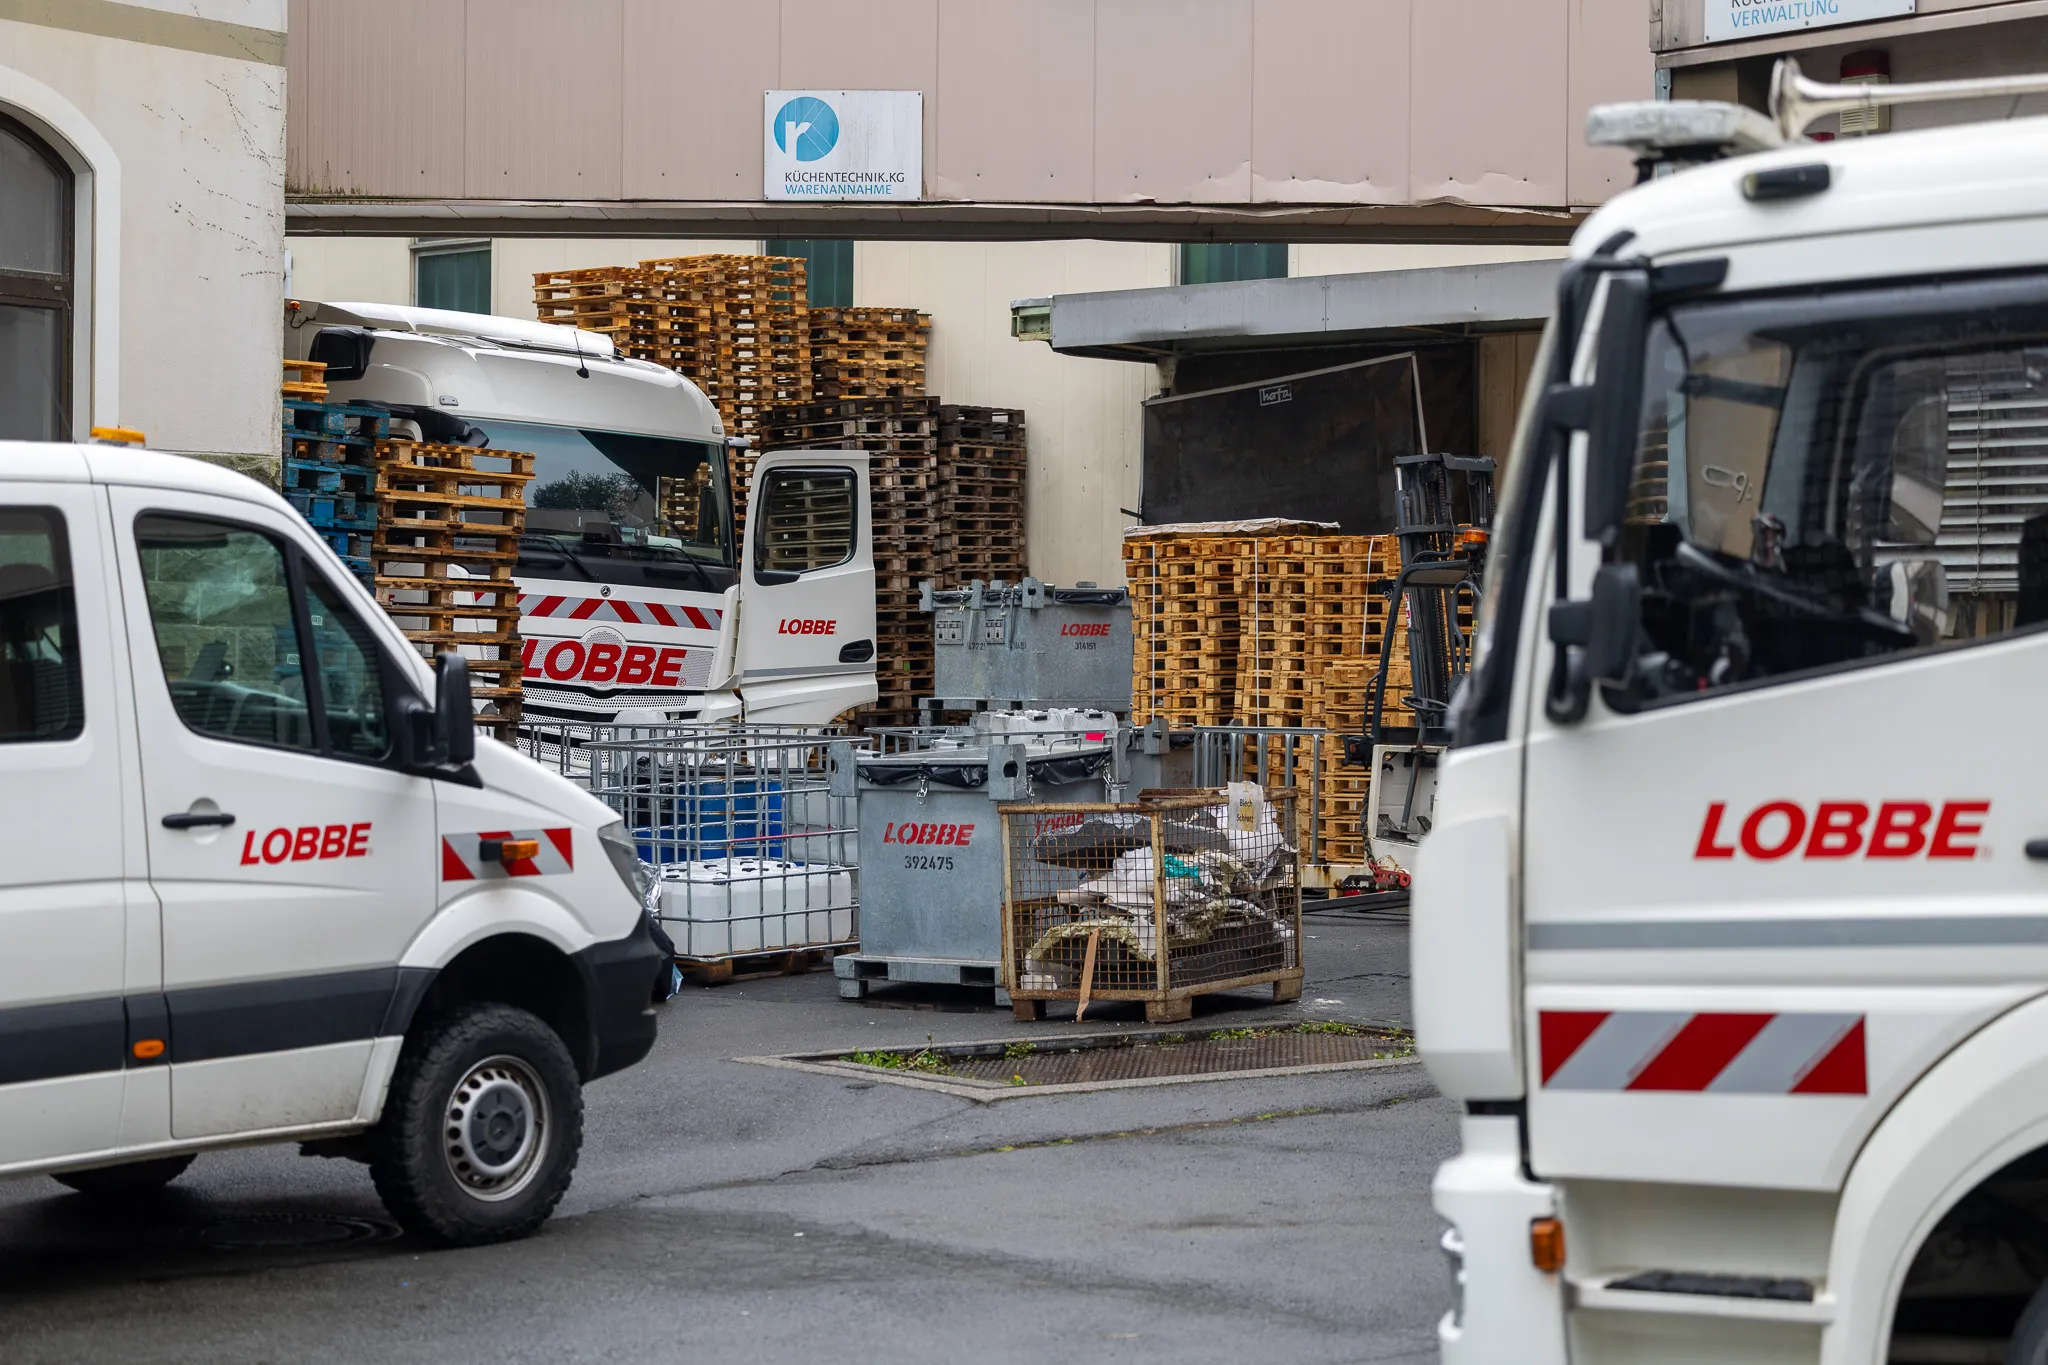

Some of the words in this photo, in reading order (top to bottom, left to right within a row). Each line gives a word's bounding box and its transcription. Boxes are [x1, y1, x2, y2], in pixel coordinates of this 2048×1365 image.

[1731, 0, 1839, 28] VERWALTUNG
[784, 170, 905, 183] KÜCHENTECHNIK.KG
[784, 184, 892, 195] WARENANNAHME
[778, 618, 837, 635] LOBBE
[1061, 623, 1111, 637] LOBBE
[521, 638, 687, 687] LOBBE
[883, 822, 975, 846] LOBBE
[1692, 798, 1991, 861] LOBBE
[239, 821, 373, 866] LOBBE
[904, 855, 953, 870] 392475
